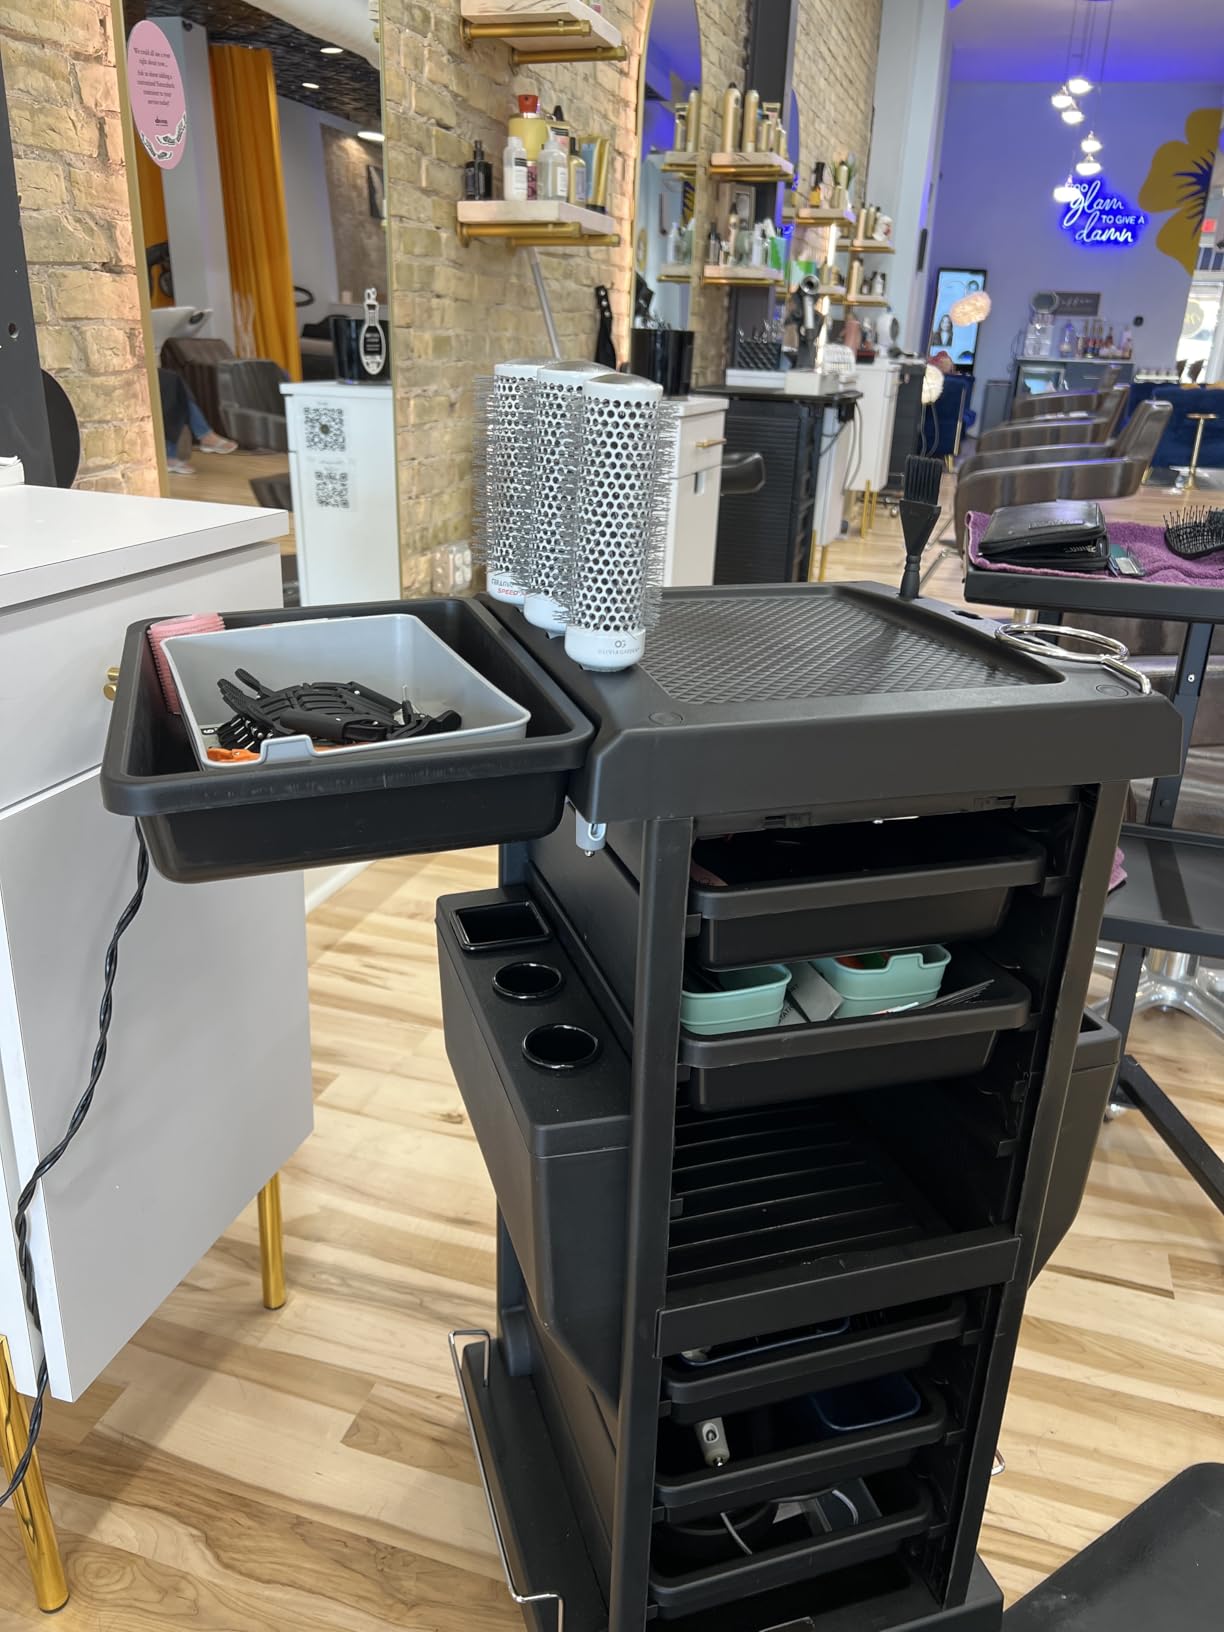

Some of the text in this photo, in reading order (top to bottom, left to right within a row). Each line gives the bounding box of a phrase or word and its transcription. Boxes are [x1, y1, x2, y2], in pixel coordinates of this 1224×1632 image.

[1063, 180, 1125, 228] glam
[1101, 214, 1145, 225] TO GIVE A
[1075, 210, 1134, 242] damn
